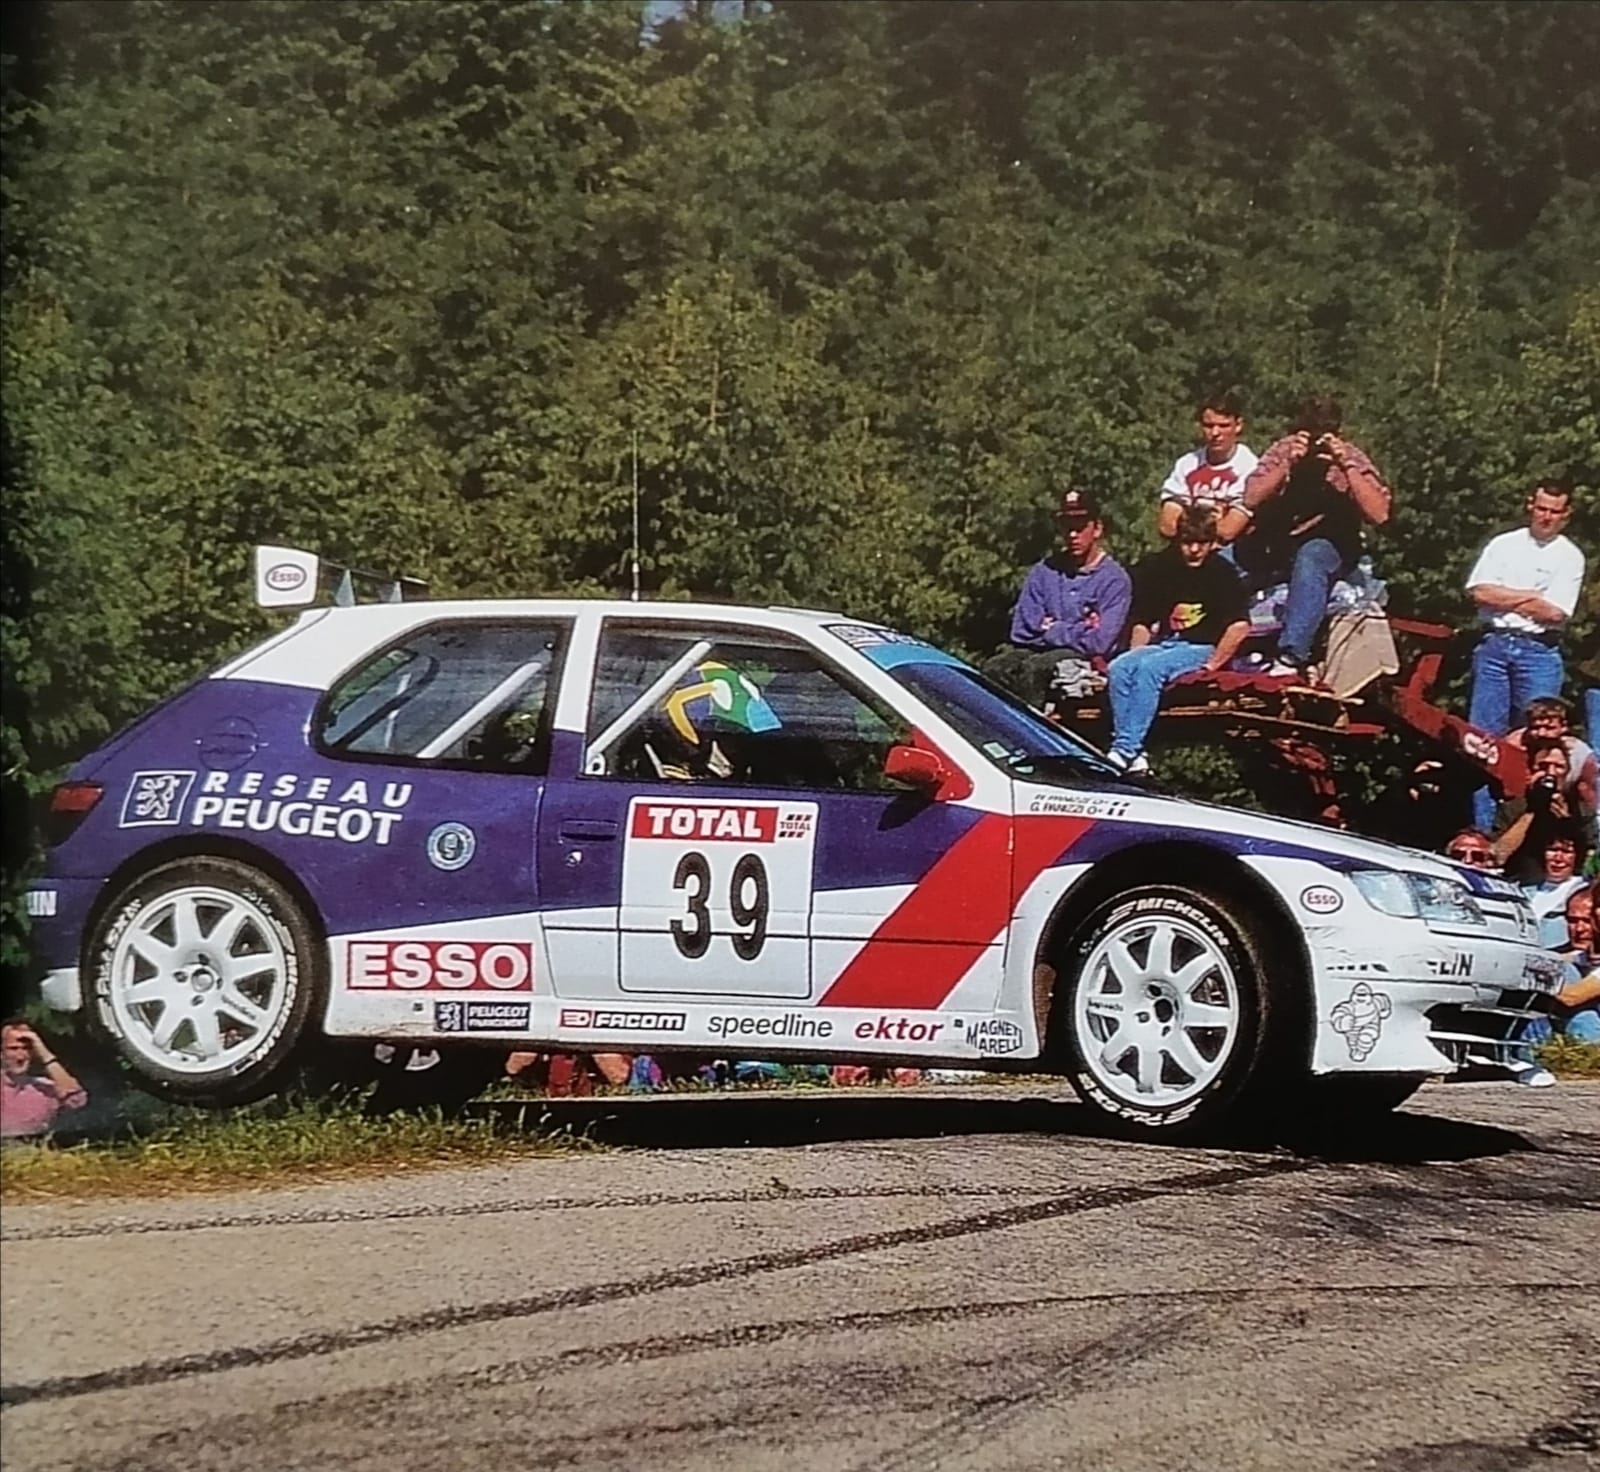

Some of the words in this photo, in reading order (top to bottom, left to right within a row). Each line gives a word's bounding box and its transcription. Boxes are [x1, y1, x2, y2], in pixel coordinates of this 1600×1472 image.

[271, 570, 302, 583] Esso
[202, 770, 413, 807] RESEAU
[191, 797, 403, 844] PEUGEOT
[648, 807, 763, 838] TOTAL
[779, 820, 811, 832] TOTAL
[669, 851, 770, 961] 39
[1307, 891, 1338, 905] Esso
[1136, 898, 1230, 946] MICHELIN
[349, 942, 530, 989] ESSO
[255, 954, 298, 1062] MICHELIN
[469, 1005, 529, 1018] PEUGEOT
[594, 1012, 684, 1030] FACOM
[707, 1013, 833, 1038] speedline
[855, 1016, 944, 1041] ektor
